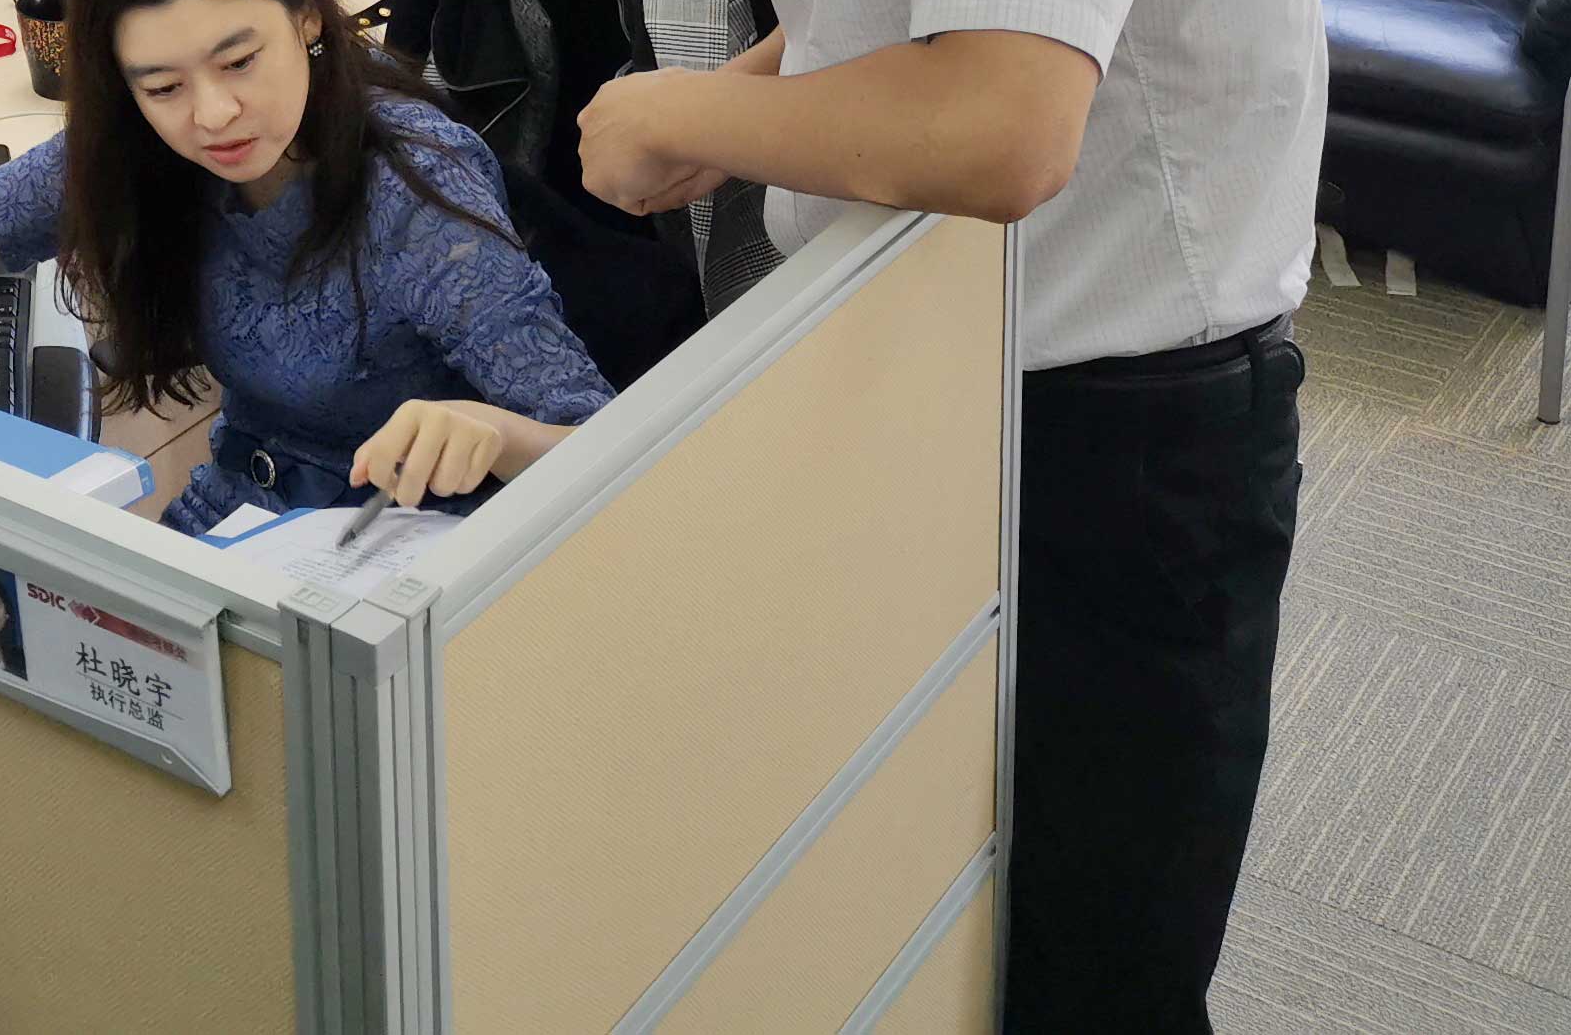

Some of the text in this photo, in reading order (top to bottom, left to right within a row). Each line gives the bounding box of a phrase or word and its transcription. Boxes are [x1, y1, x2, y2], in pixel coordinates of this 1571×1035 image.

[27, 582, 65, 612] SDIC
[76, 641, 172, 707] 杜晓宇
[89, 682, 165, 731] 执行总监
